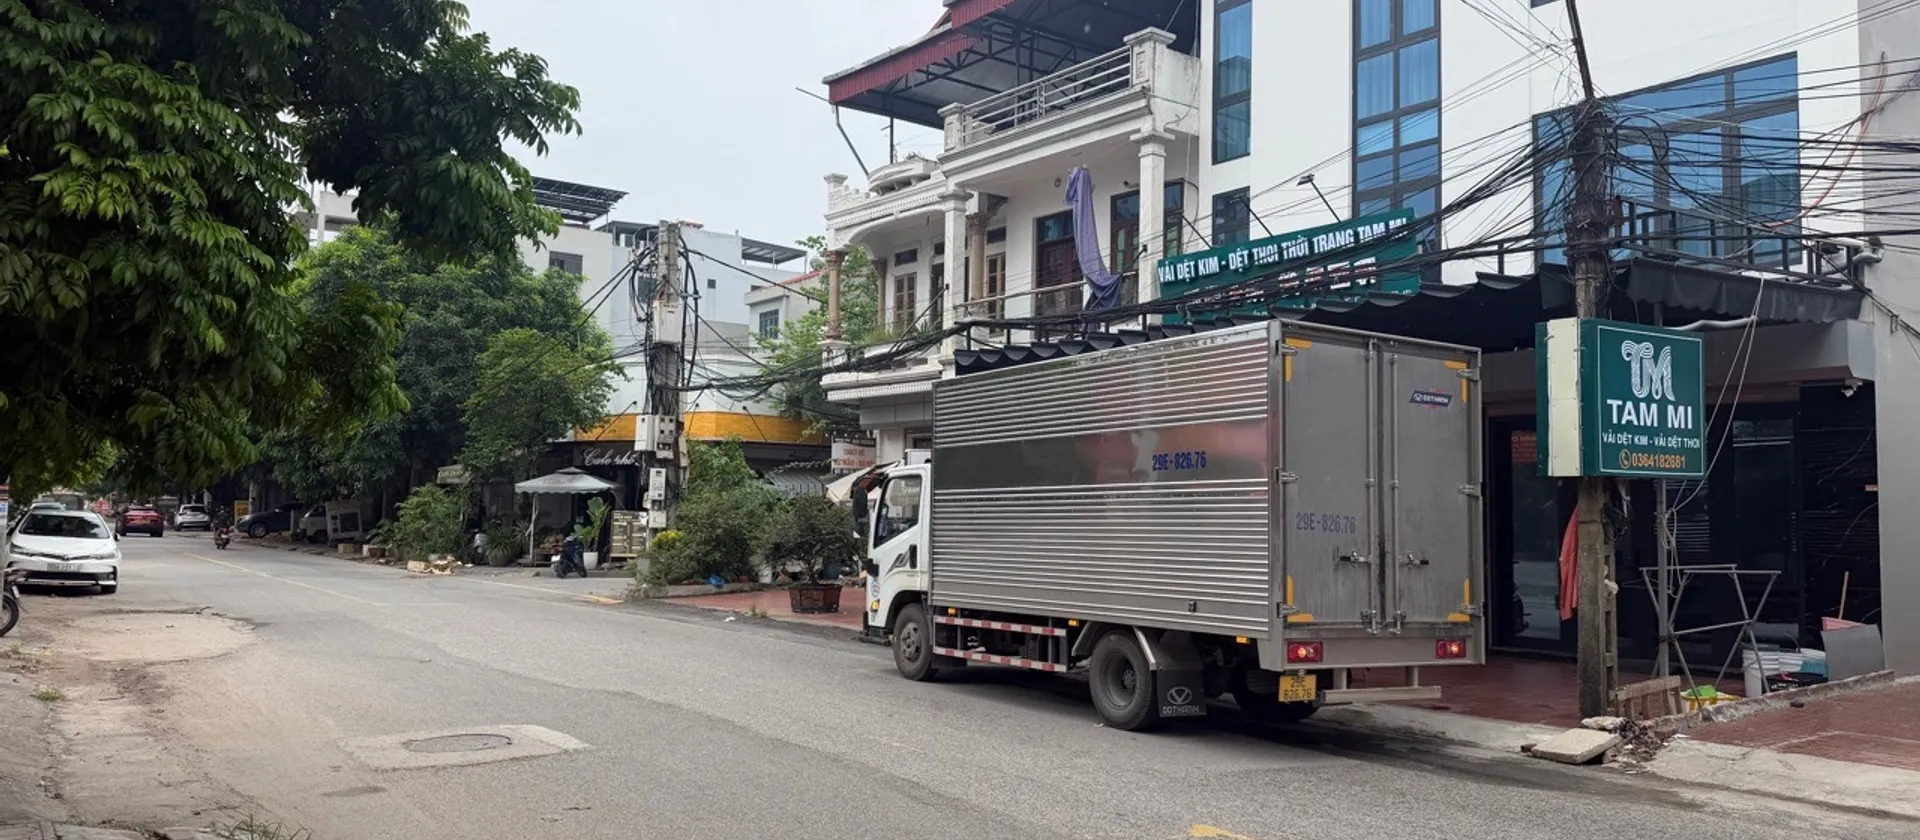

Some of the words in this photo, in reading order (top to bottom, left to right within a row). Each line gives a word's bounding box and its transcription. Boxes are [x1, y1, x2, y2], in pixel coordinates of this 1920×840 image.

[1158, 261, 1176, 283] VẢI
[1177, 259, 1196, 282] DỆT
[1198, 256, 1220, 276] KIM
[1228, 248, 1249, 273] DỆT
[1252, 244, 1279, 265] THOI
[1313, 227, 1355, 254] TRANG
[1357, 222, 1386, 243] TAM
[1607, 399, 1658, 427] TAM
[1667, 405, 1693, 429] MI
[1602, 429, 1615, 443] VẢI
[1617, 432, 1632, 446] DỆT
[1634, 435, 1648, 445] KIM
[1654, 433, 1666, 447] VẢI
[1667, 436, 1681, 449] DỆT
[1683, 438, 1700, 449] THOI
[1152, 451, 1207, 471] 29E-826.76
[1632, 453, 1685, 468] 0364182681
[1296, 512, 1356, 534] 29E-826.76
[1290, 676, 1306, 688] 29E
